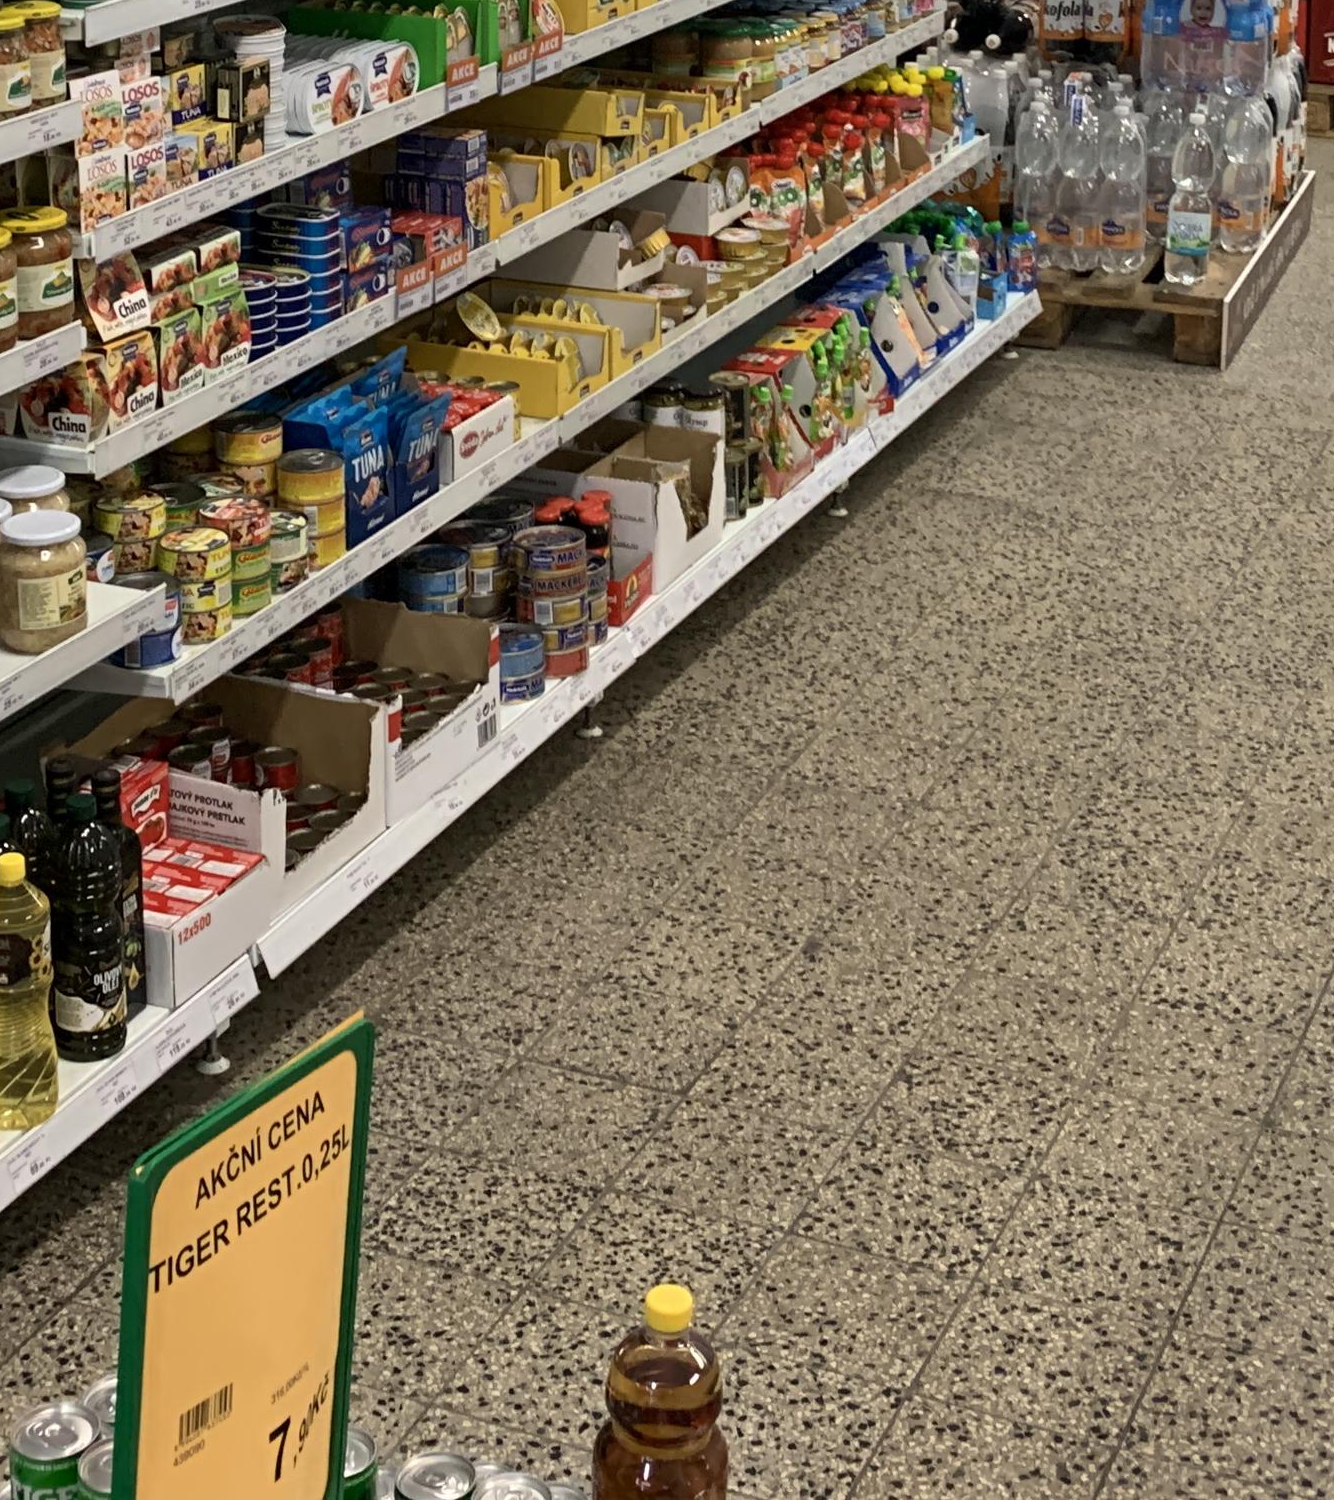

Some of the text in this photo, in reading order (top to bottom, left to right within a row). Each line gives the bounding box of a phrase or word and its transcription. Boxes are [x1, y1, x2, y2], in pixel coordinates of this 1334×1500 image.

[451, 64, 475, 82] AKCE
[122, 83, 160, 105] LOSOS
[181, 108, 202, 121] TUNA
[131, 146, 164, 170] LOSOS
[87, 161, 117, 181] LOSOS
[440, 252, 464, 270] AKCE
[402, 272, 427, 290] AKCE
[119, 297, 147, 321] China
[130, 389, 157, 414] China
[53, 415, 87, 434] China
[352, 445, 384, 484] TUNA
[193, 794, 233, 810] PROTLAK
[177, 912, 211, 945] 12x500
[195, 1091, 325, 1210] AKČNÍ CENA
[148, 1219, 231, 1294] TIGER
